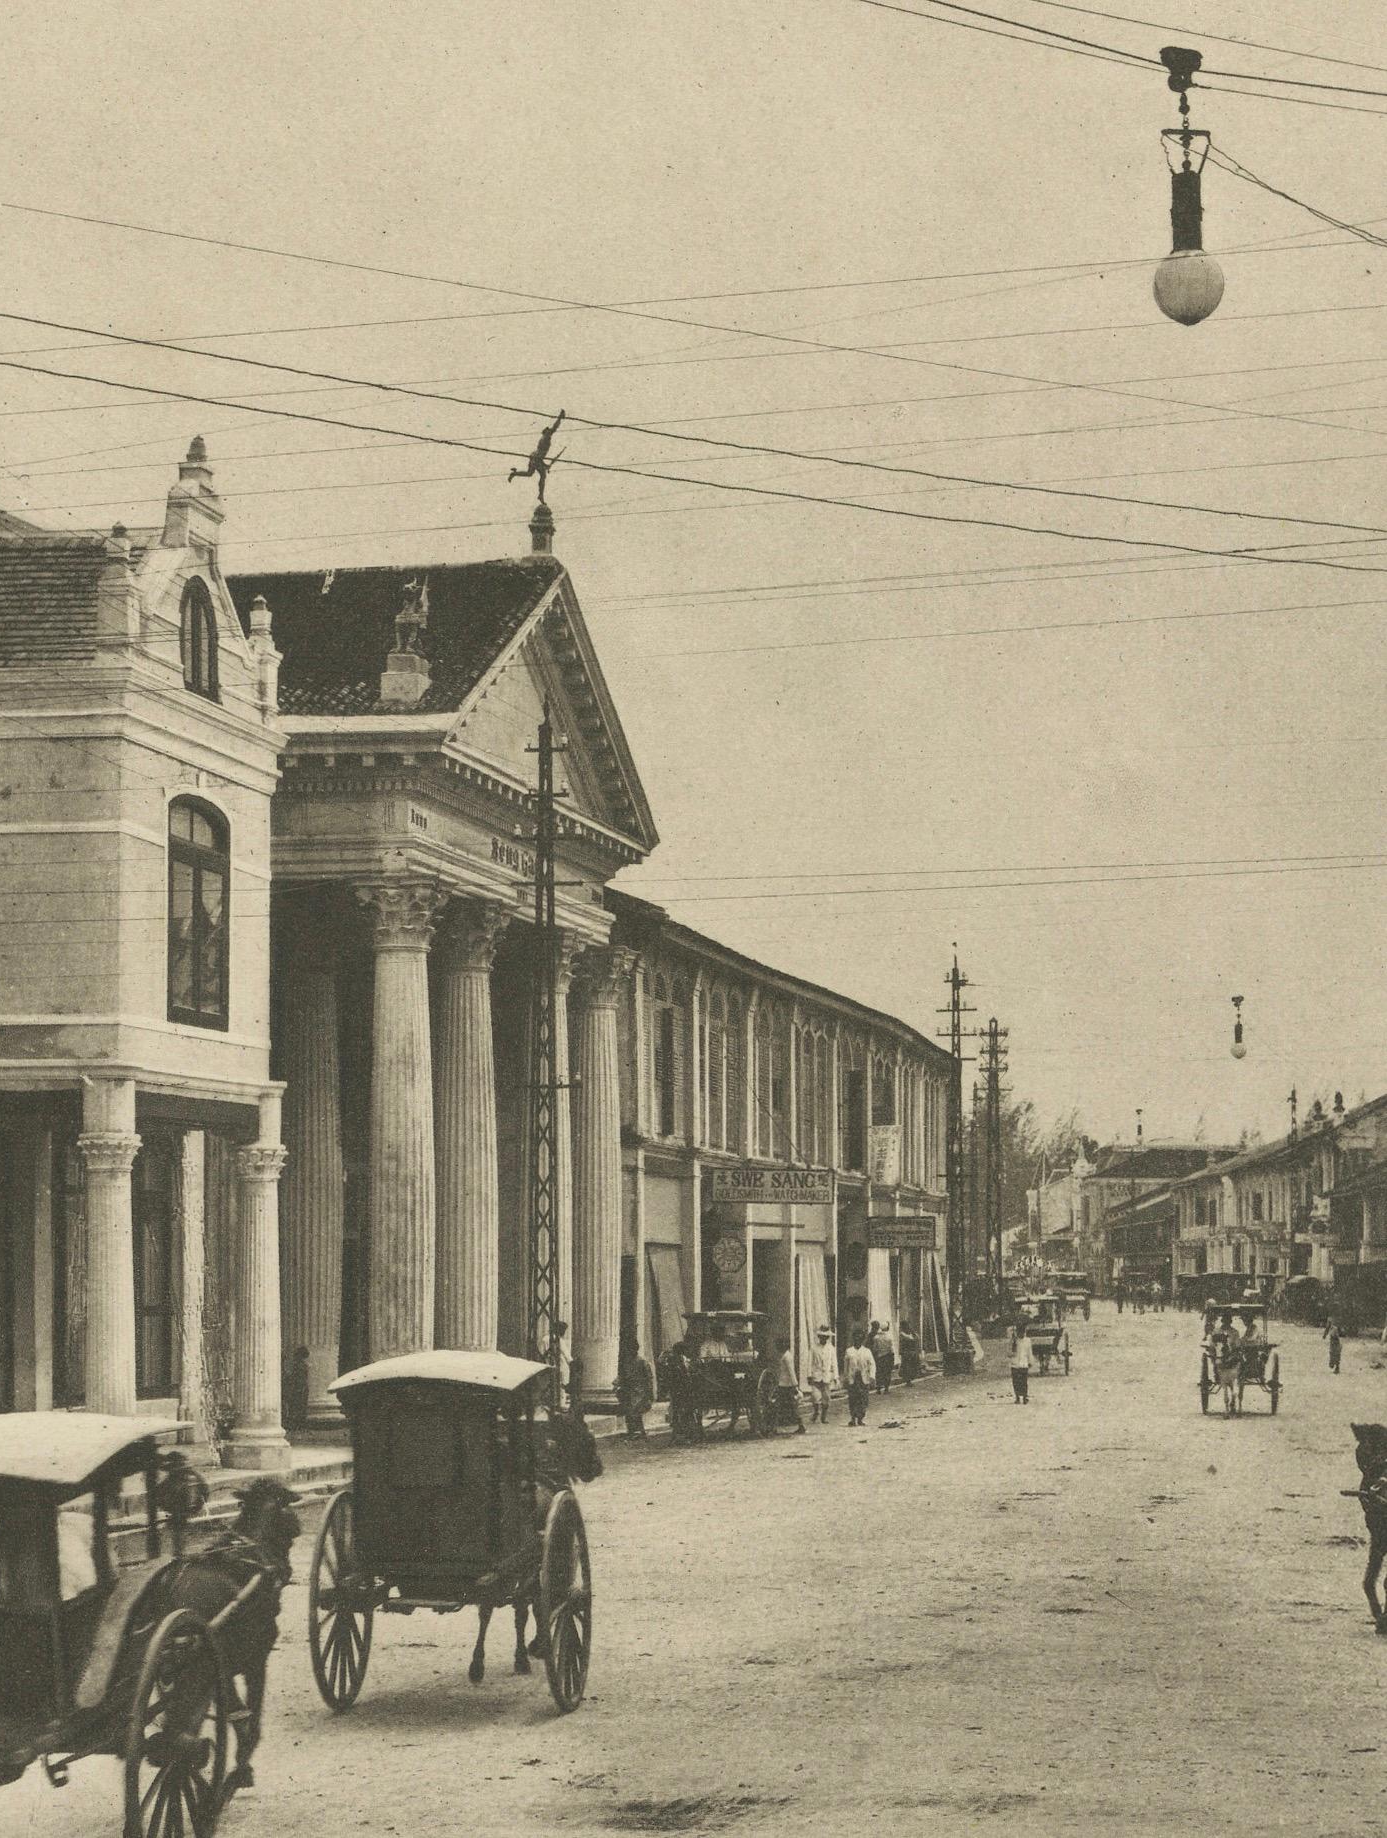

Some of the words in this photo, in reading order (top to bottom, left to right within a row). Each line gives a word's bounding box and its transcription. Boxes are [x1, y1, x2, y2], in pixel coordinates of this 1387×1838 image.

[731, 1171, 765, 1188] SWE
[771, 1172, 816, 1189] SANG
[715, 1188, 764, 1200] GOLDSMITH
[773, 1189, 830, 1201] WATCHMAKER
